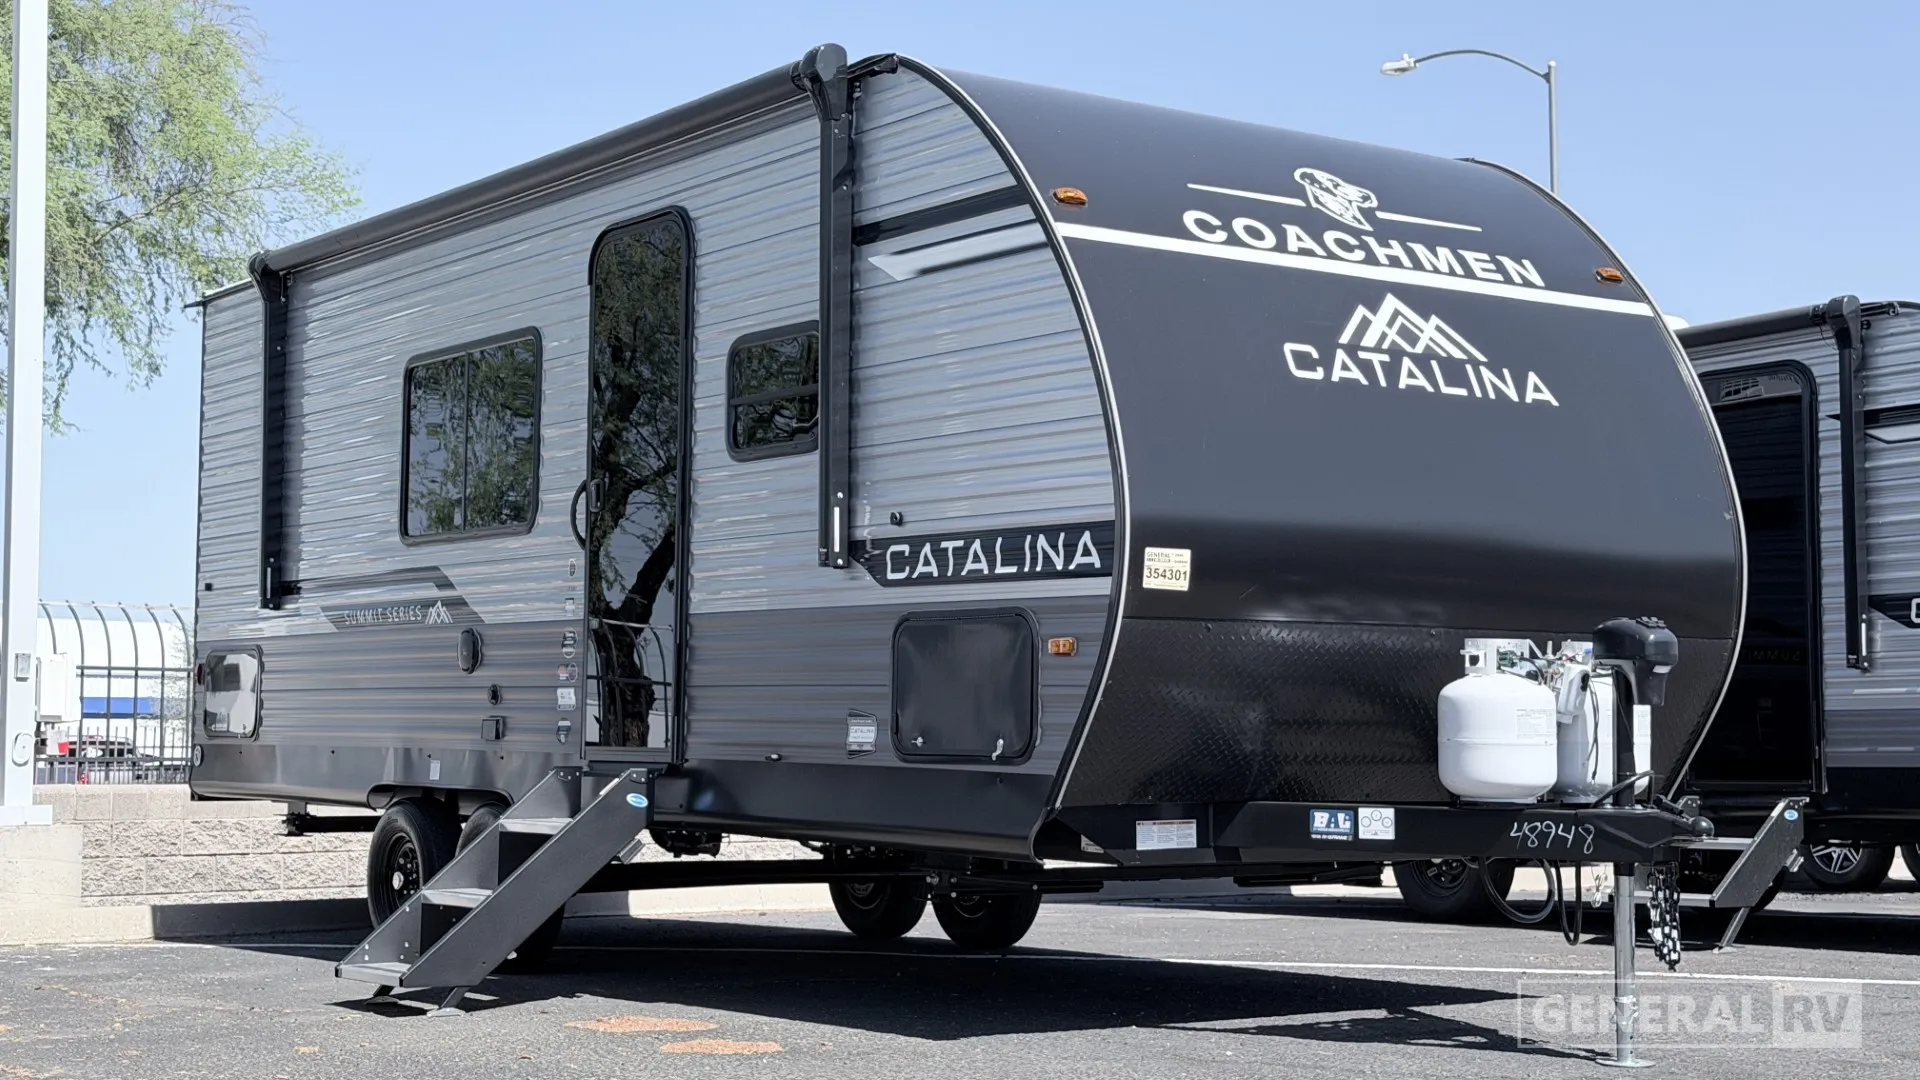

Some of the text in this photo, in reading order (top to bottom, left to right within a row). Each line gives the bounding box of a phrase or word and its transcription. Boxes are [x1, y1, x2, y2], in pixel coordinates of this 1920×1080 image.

[1183, 209, 1546, 288] COACHMEN
[1283, 342, 1560, 407] CATALINA
[885, 530, 1101, 581] CATALINA
[1145, 567, 1187, 581] 354301
[344, 605, 422, 625] SUMMIT SERIES
[1510, 821, 1595, 854] 48948
